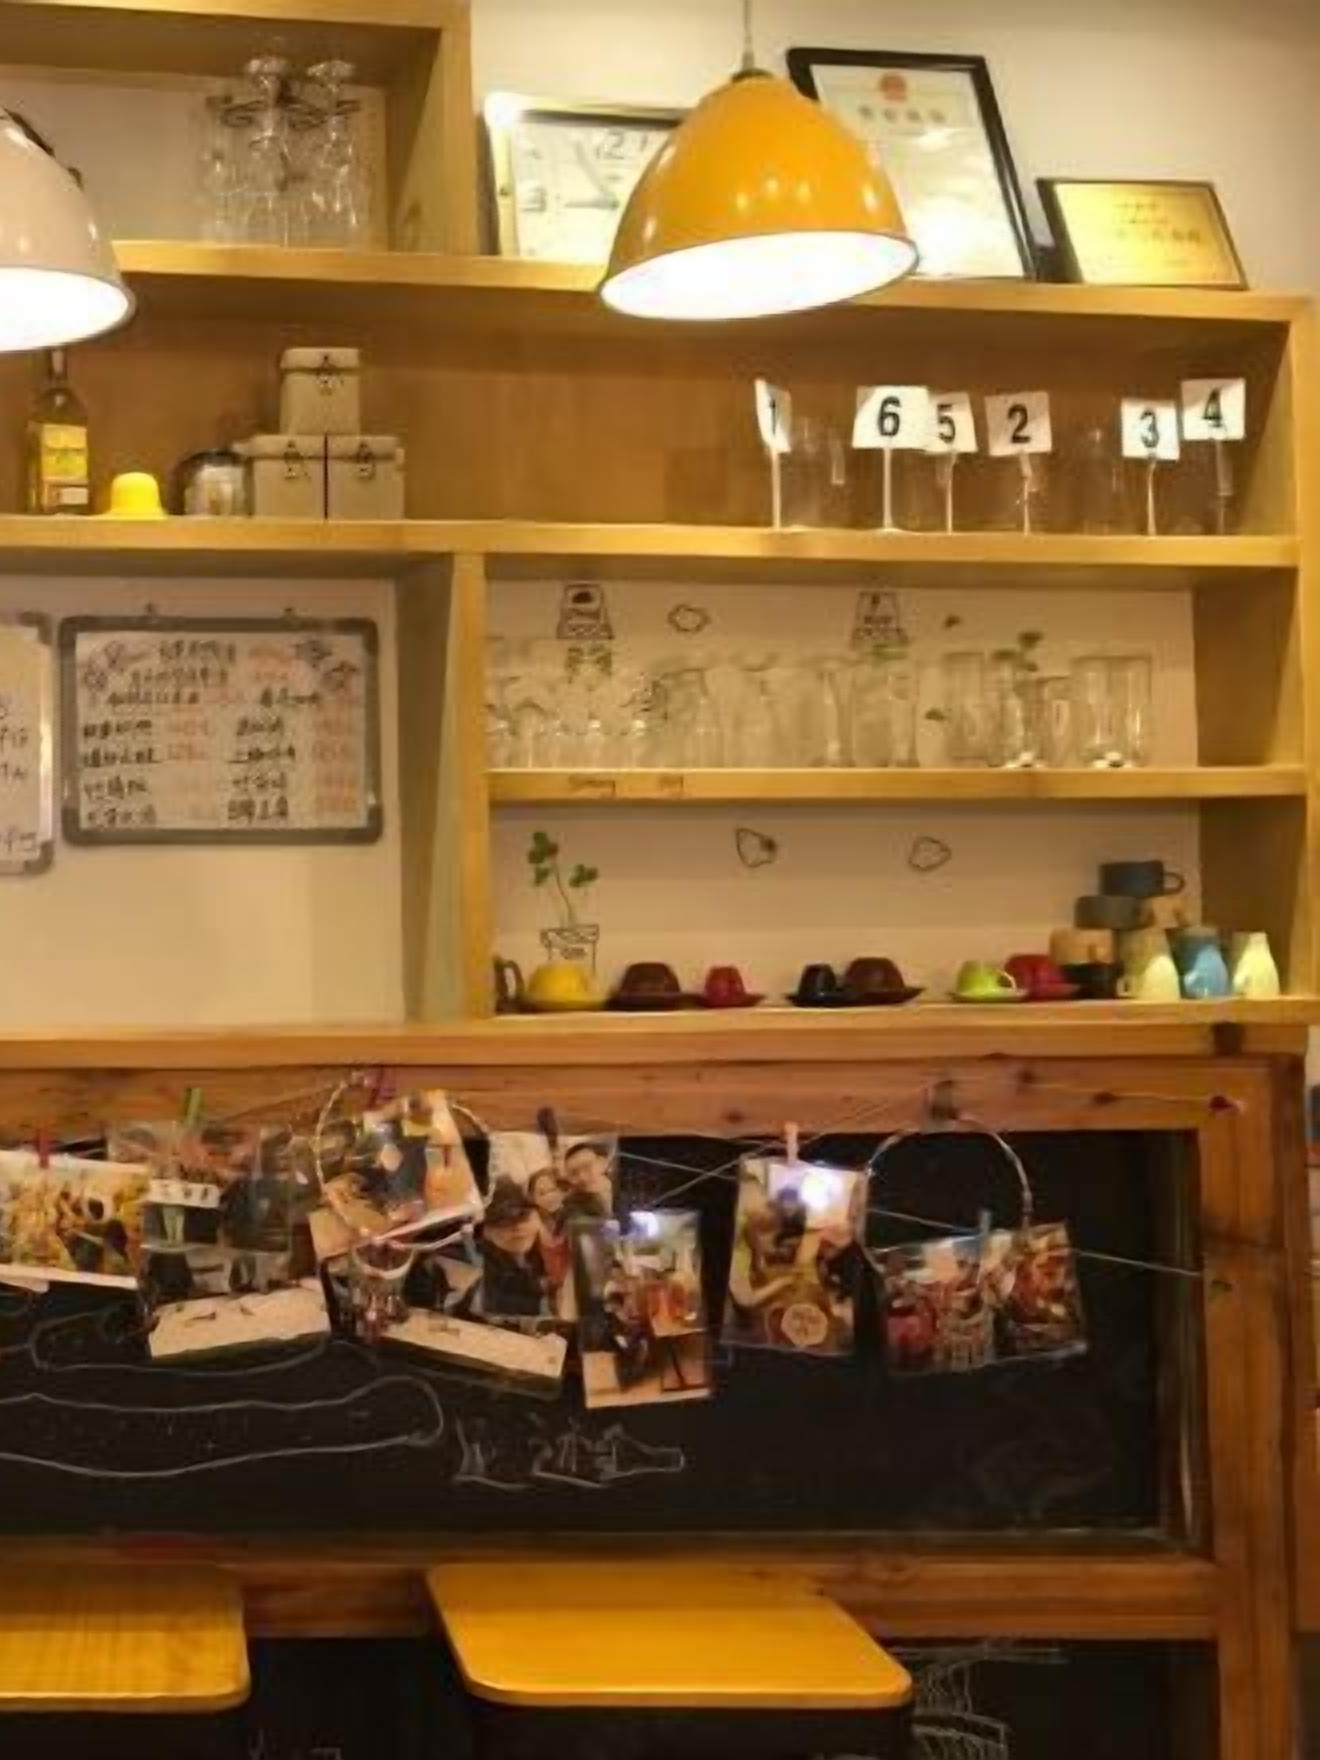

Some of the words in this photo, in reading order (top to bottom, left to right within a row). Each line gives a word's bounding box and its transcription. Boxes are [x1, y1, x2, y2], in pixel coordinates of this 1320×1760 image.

[877, 396, 902, 437] 6
[937, 403, 957, 443] 5
[1006, 403, 1032, 444] 2
[1202, 387, 1224, 429] 4
[1139, 410, 1161, 449] 3
